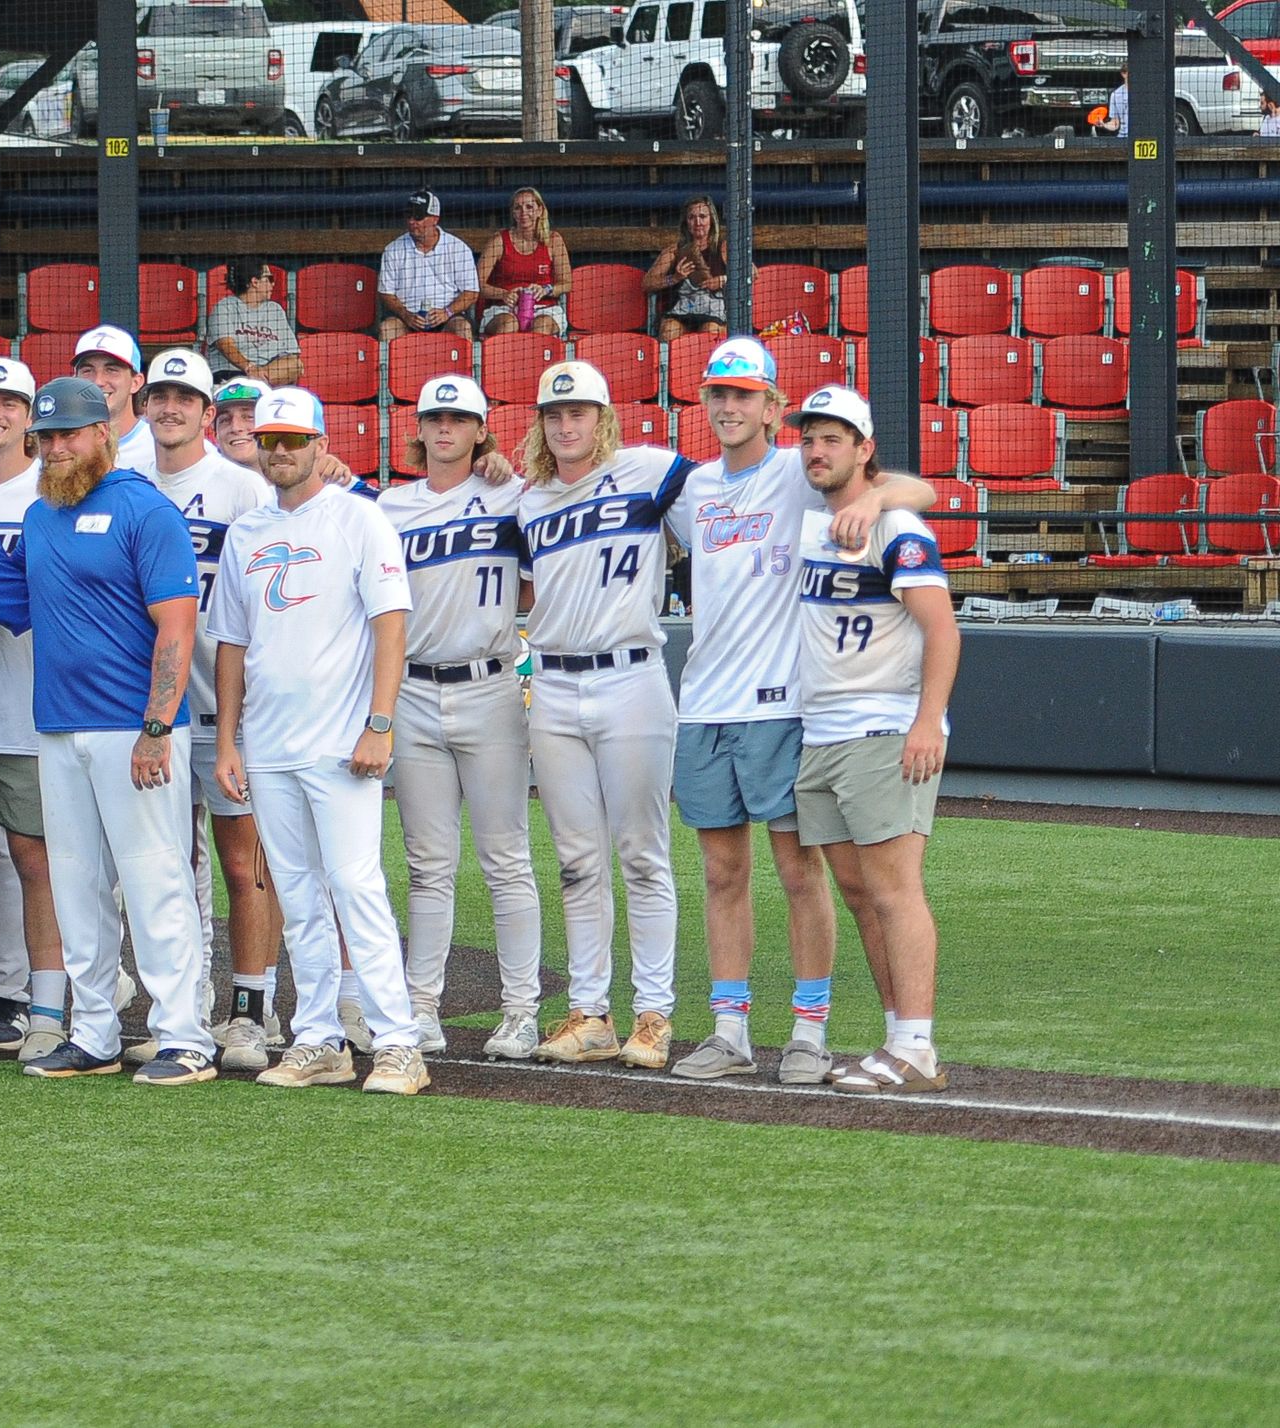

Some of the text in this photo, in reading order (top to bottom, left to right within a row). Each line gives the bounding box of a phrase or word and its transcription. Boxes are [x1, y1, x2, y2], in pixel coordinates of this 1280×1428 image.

[109, 140, 129, 155] 102
[1136, 143, 1155, 158] 102
[696, 503, 774, 554] TROPICS
[599, 544, 640, 590] 14
[751, 545, 791, 578] 15
[477, 566, 505, 607] 11
[836, 615, 874, 653] 19
